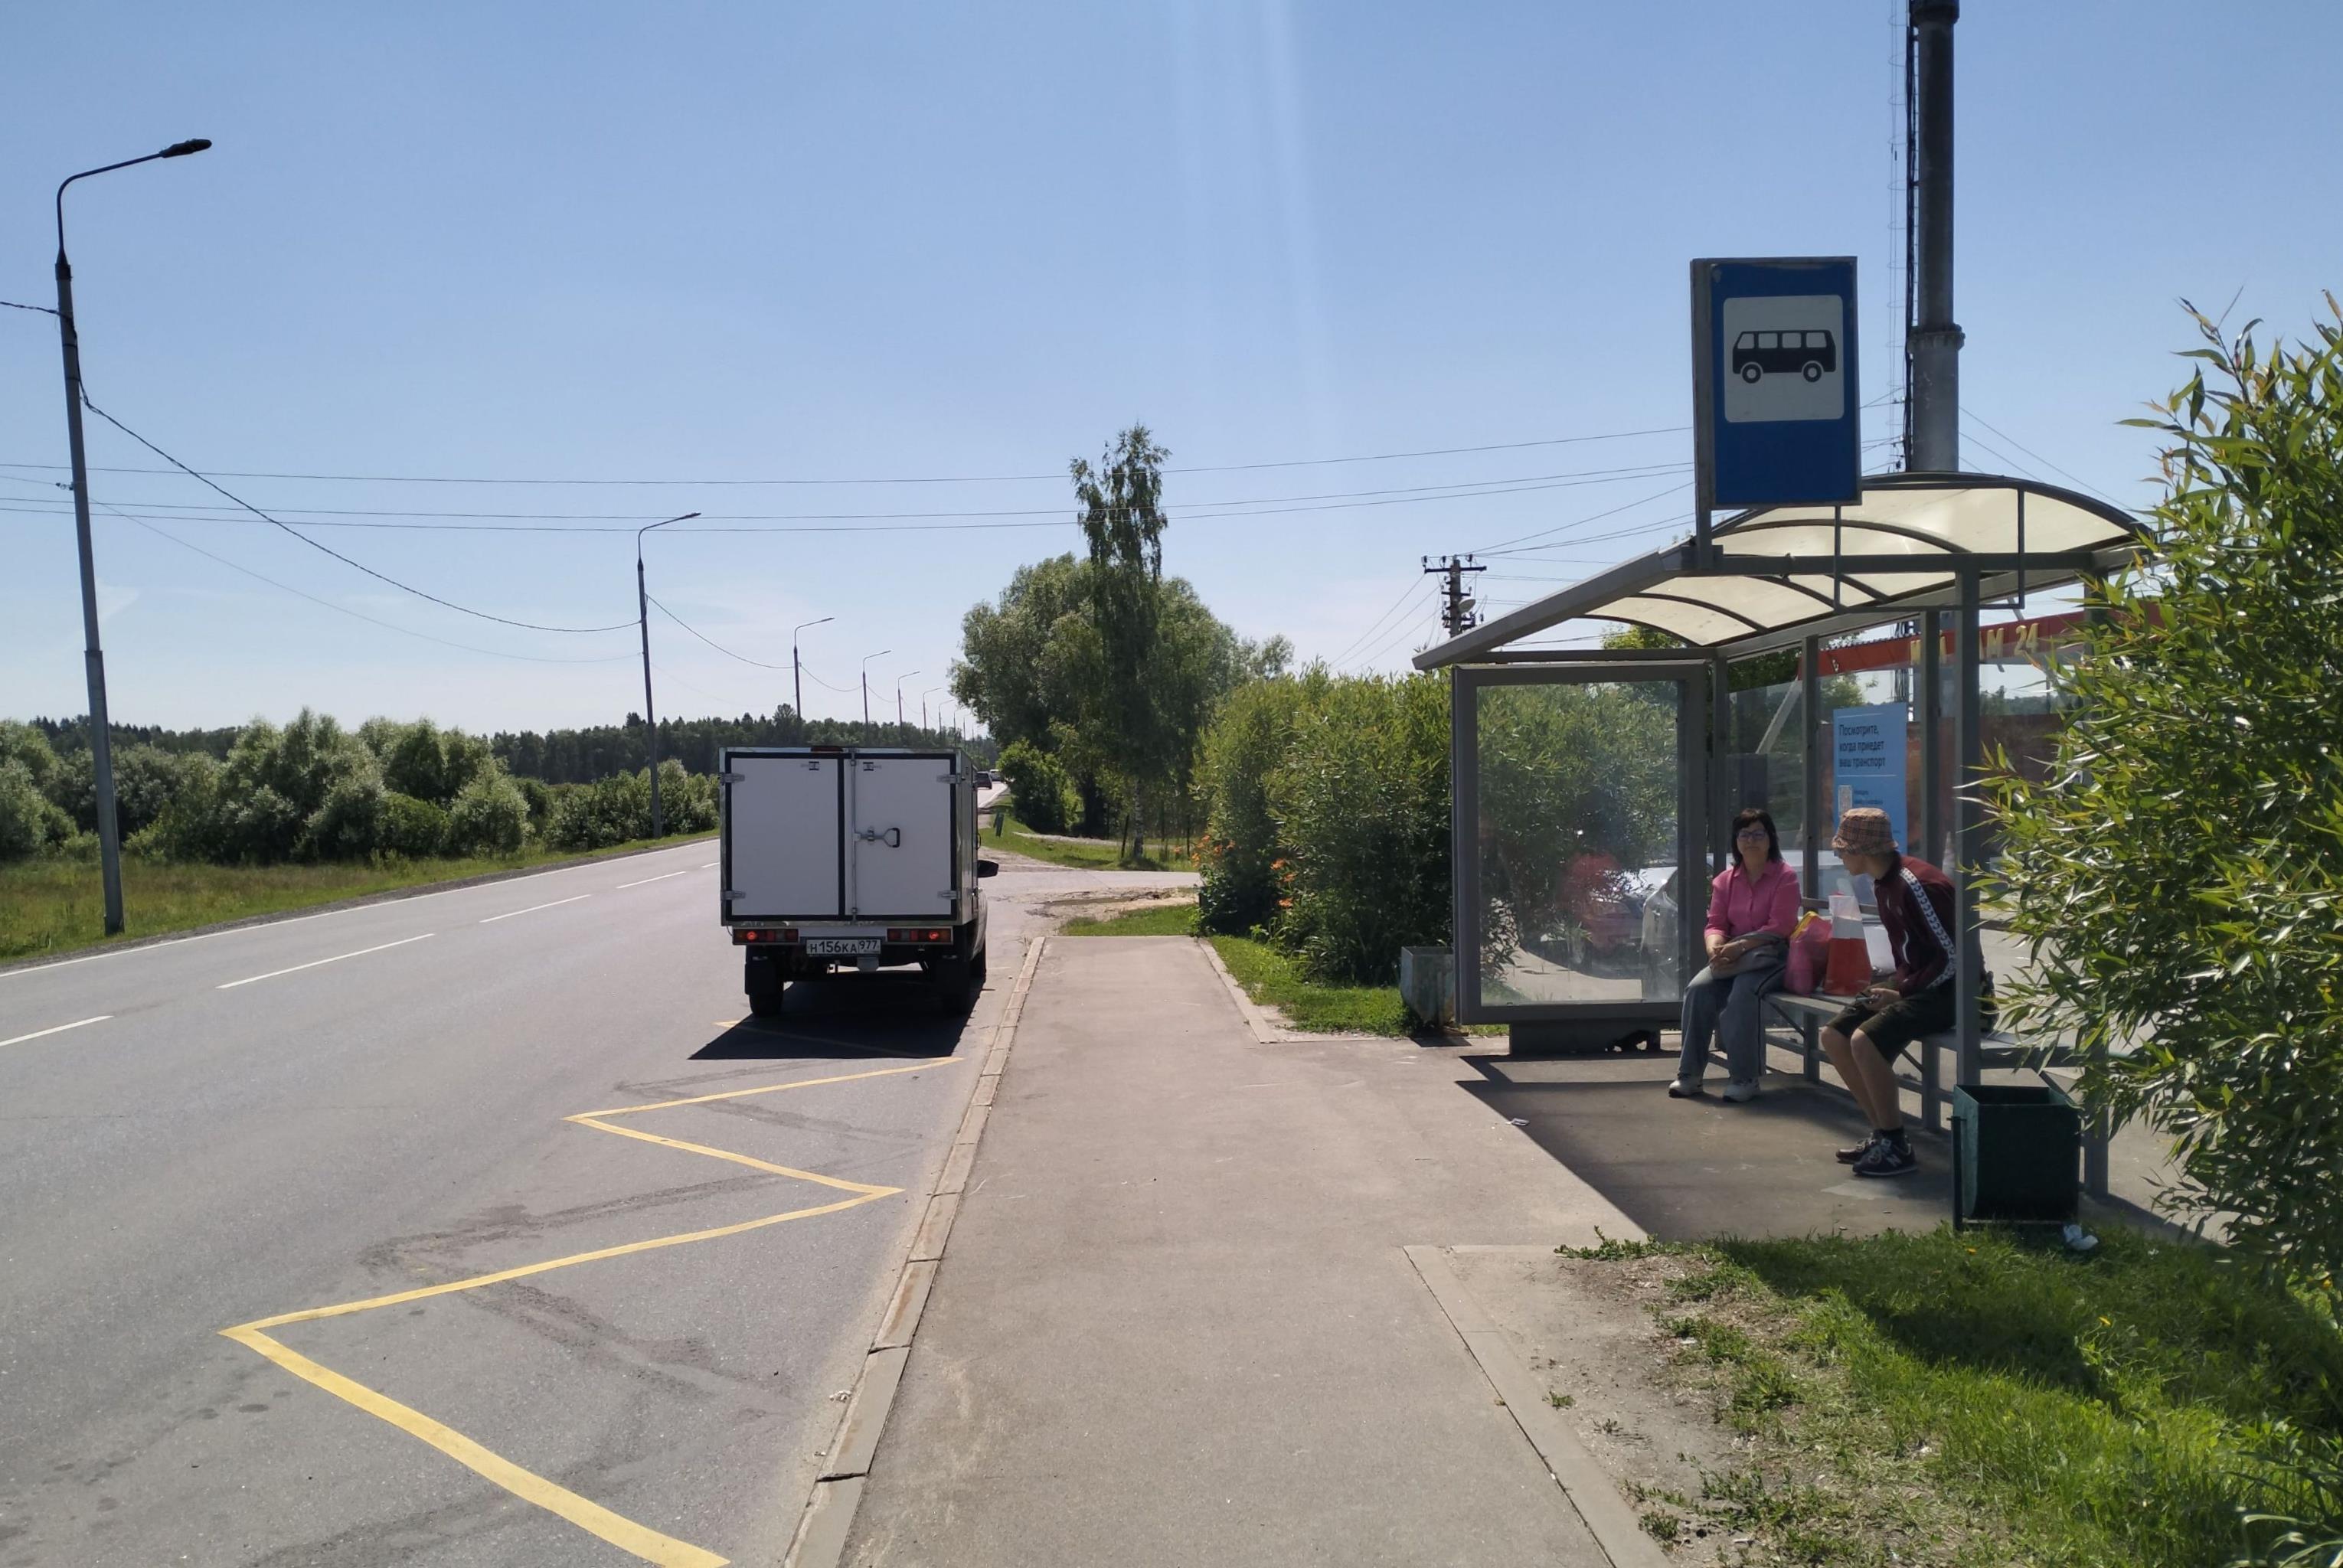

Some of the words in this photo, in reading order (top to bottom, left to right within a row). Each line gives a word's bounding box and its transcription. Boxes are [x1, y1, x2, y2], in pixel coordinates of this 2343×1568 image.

[2014, 622, 2038, 656] 24
[1839, 724, 1880, 737] Посмотрите,
[1839, 743, 1856, 752] когда
[1853, 757, 1885, 769] транспорт
